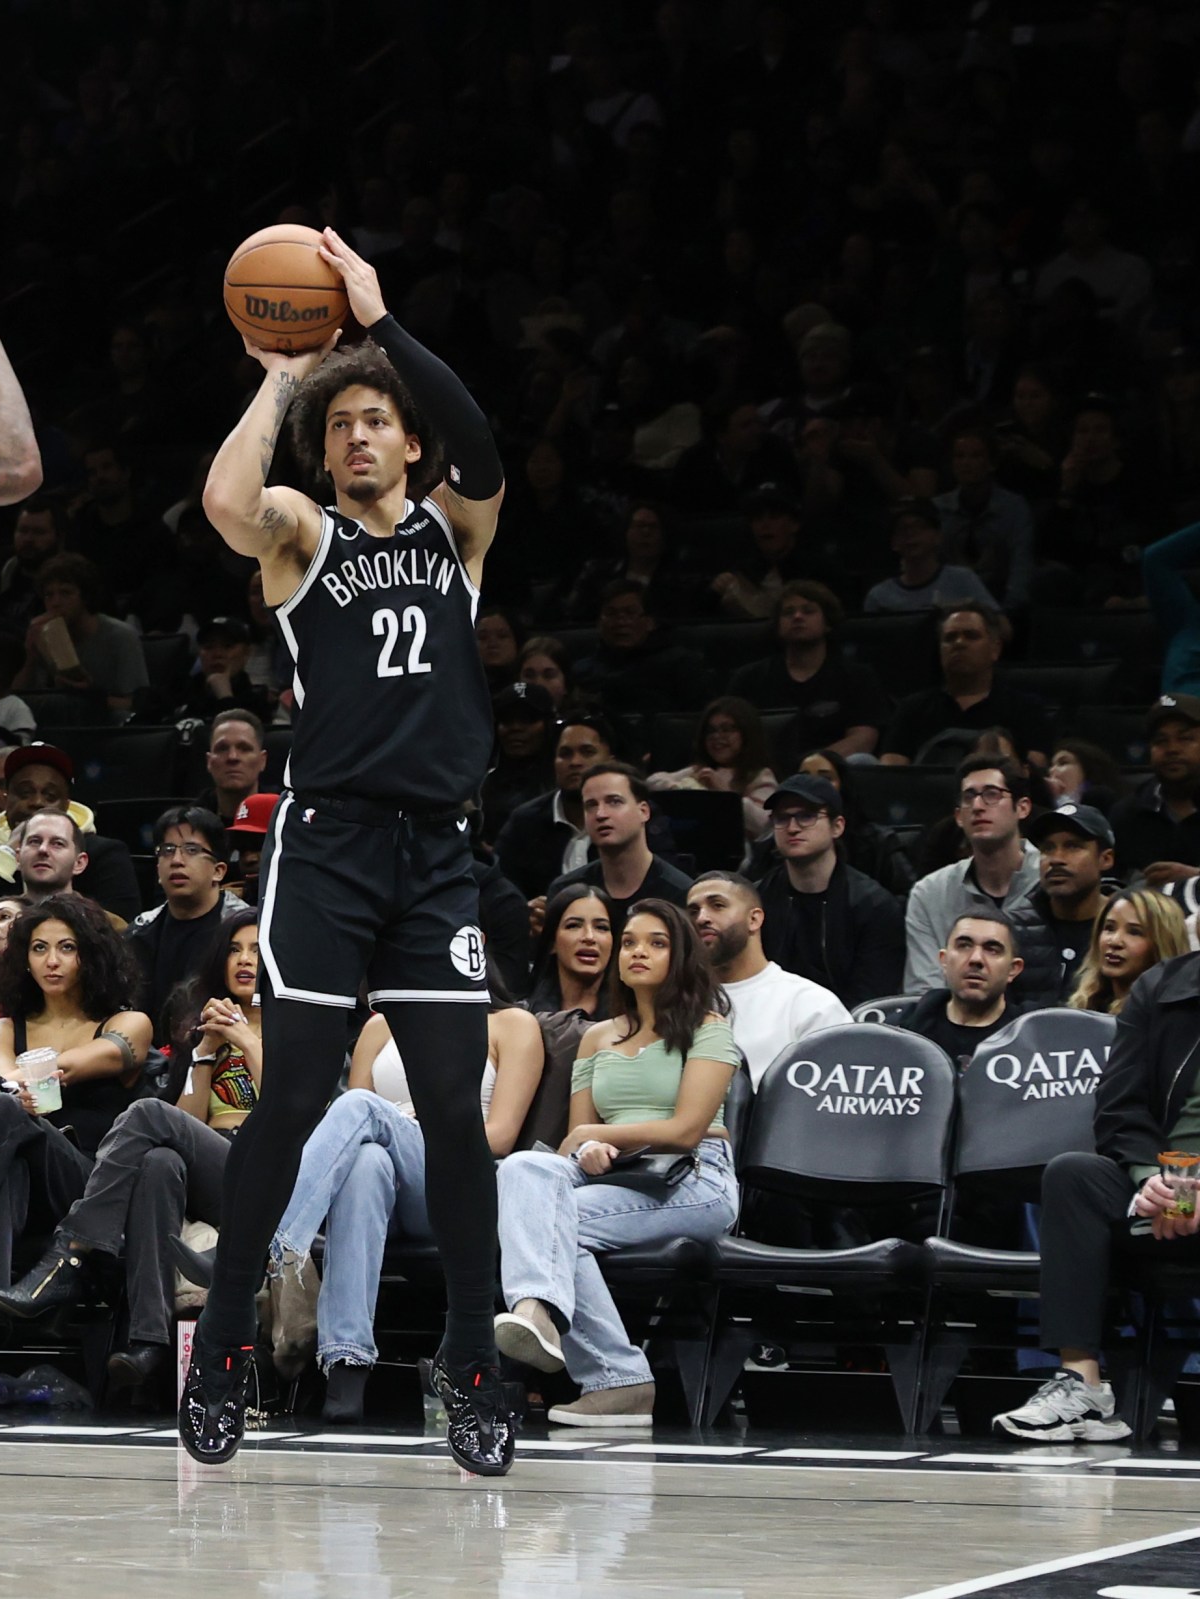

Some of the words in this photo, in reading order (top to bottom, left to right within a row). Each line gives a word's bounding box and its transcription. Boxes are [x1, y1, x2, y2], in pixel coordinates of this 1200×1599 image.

[245, 293, 329, 322] Wilson
[321, 548, 456, 608] BROOKLYN
[371, 605, 432, 678] 22
[786, 1060, 925, 1098] QATAR
[816, 1095, 922, 1116] AIRWAYS
